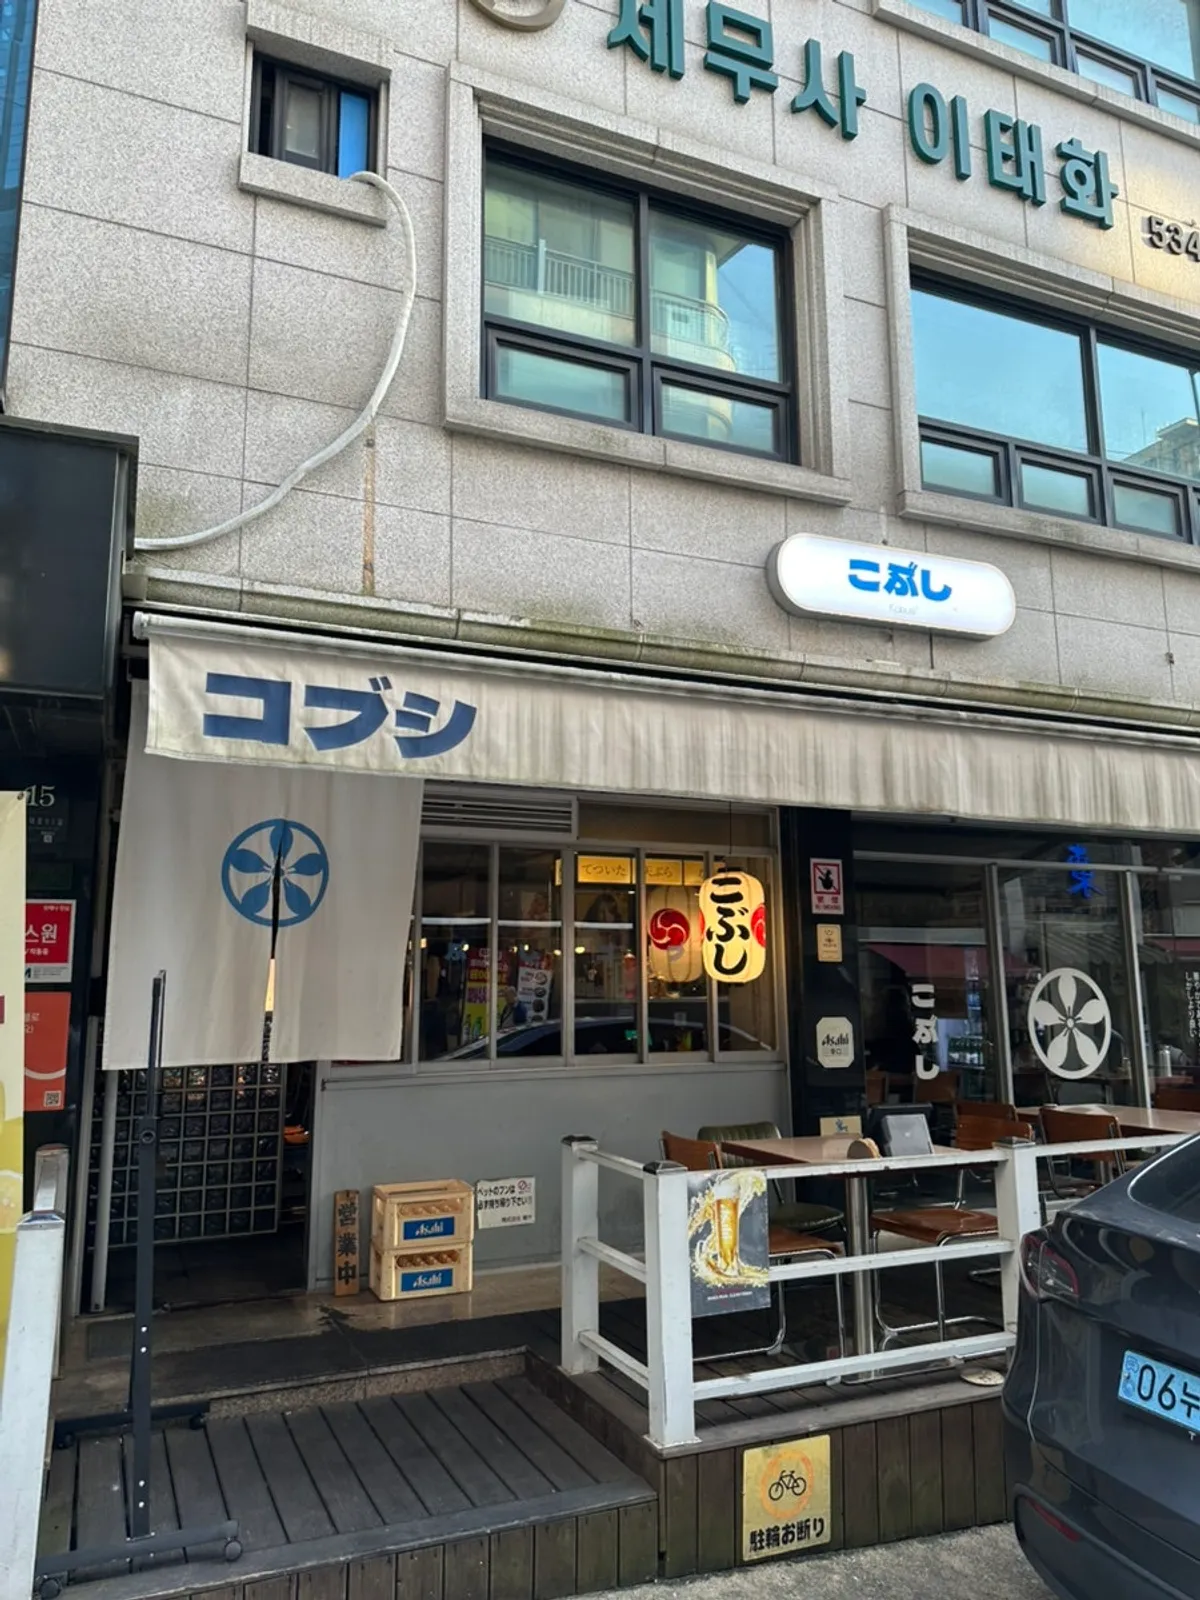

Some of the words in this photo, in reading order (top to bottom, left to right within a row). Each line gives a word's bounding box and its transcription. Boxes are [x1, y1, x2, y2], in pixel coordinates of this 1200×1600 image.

[607, 0, 866, 141] 세무사
[908, 82, 1118, 230] 이태화
[848, 558, 952, 601] こぶし
[203, 671, 477, 759] コブシ
[706, 876, 751, 976] こぶし
[821, 1033, 850, 1047] Asahi
[911, 983, 940, 1080] こぶし
[337, 1202, 358, 1286] 営業中
[415, 1221, 444, 1237] Asahi
[413, 1271, 443, 1288] Asahi
[750, 1517, 825, 1553] 駐輪お断り
